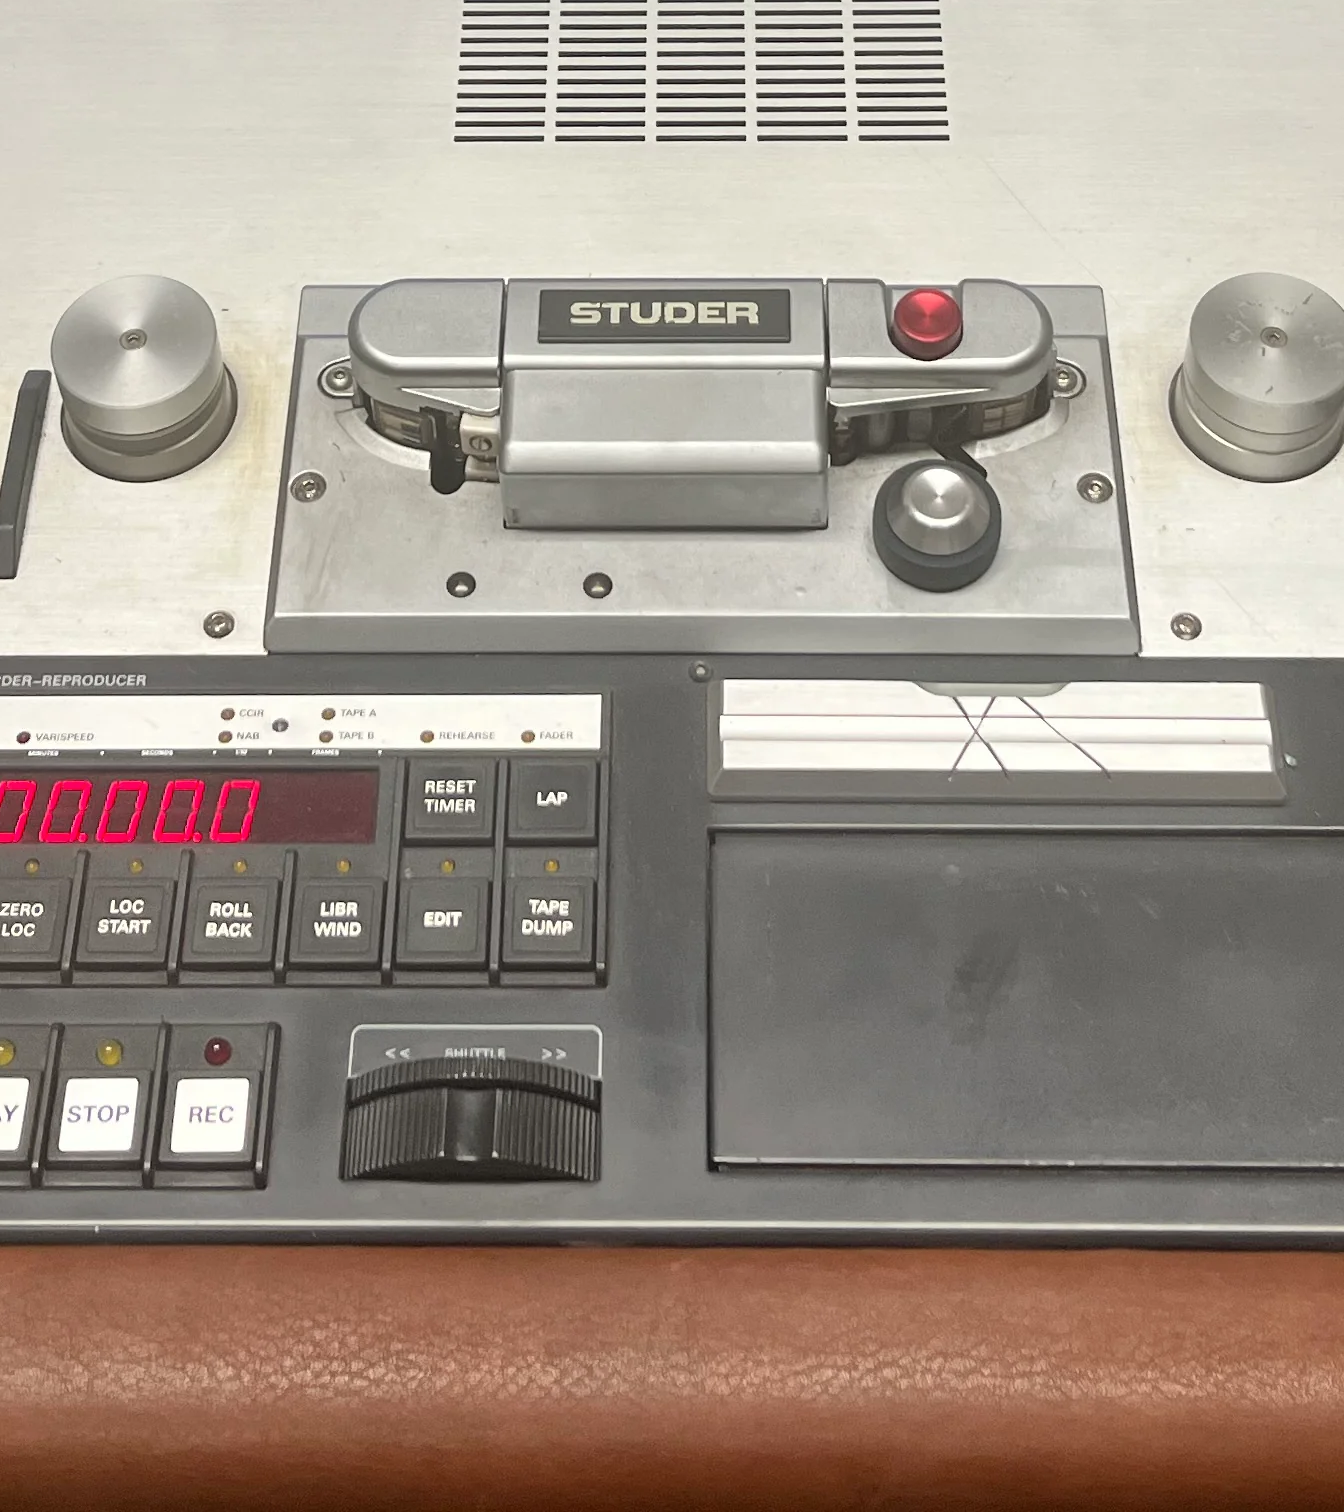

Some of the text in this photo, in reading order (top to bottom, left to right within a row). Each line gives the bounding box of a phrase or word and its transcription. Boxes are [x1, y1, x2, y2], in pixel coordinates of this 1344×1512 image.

[570, 301, 761, 325] STUDER
[239, 708, 264, 718] CCIR
[341, 708, 377, 718] TAPE A
[35, 732, 94, 742] VARISPEED
[236, 731, 260, 740] NAB
[339, 731, 375, 740] TAPE B
[439, 731, 495, 740] REHEARSE
[539, 731, 574, 740] FADER
[424, 779, 477, 794] RESET
[424, 798, 476, 813] TIMER
[536, 791, 568, 806] LAP
[0, 902, 44, 917] ZERO
[109, 899, 145, 914] LOC
[209, 901, 253, 918] ROLL
[319, 901, 358, 917] LIBR
[528, 899, 570, 916] TAPE
[97, 918, 152, 934] START
[423, 911, 463, 928] EDIT
[1, 922, 36, 937] LOC
[205, 921, 253, 938] BACK
[314, 920, 362, 937] WIND
[521, 919, 574, 936] DUMP
[67, 1104, 131, 1124] STOP
[188, 1104, 235, 1124] REC
